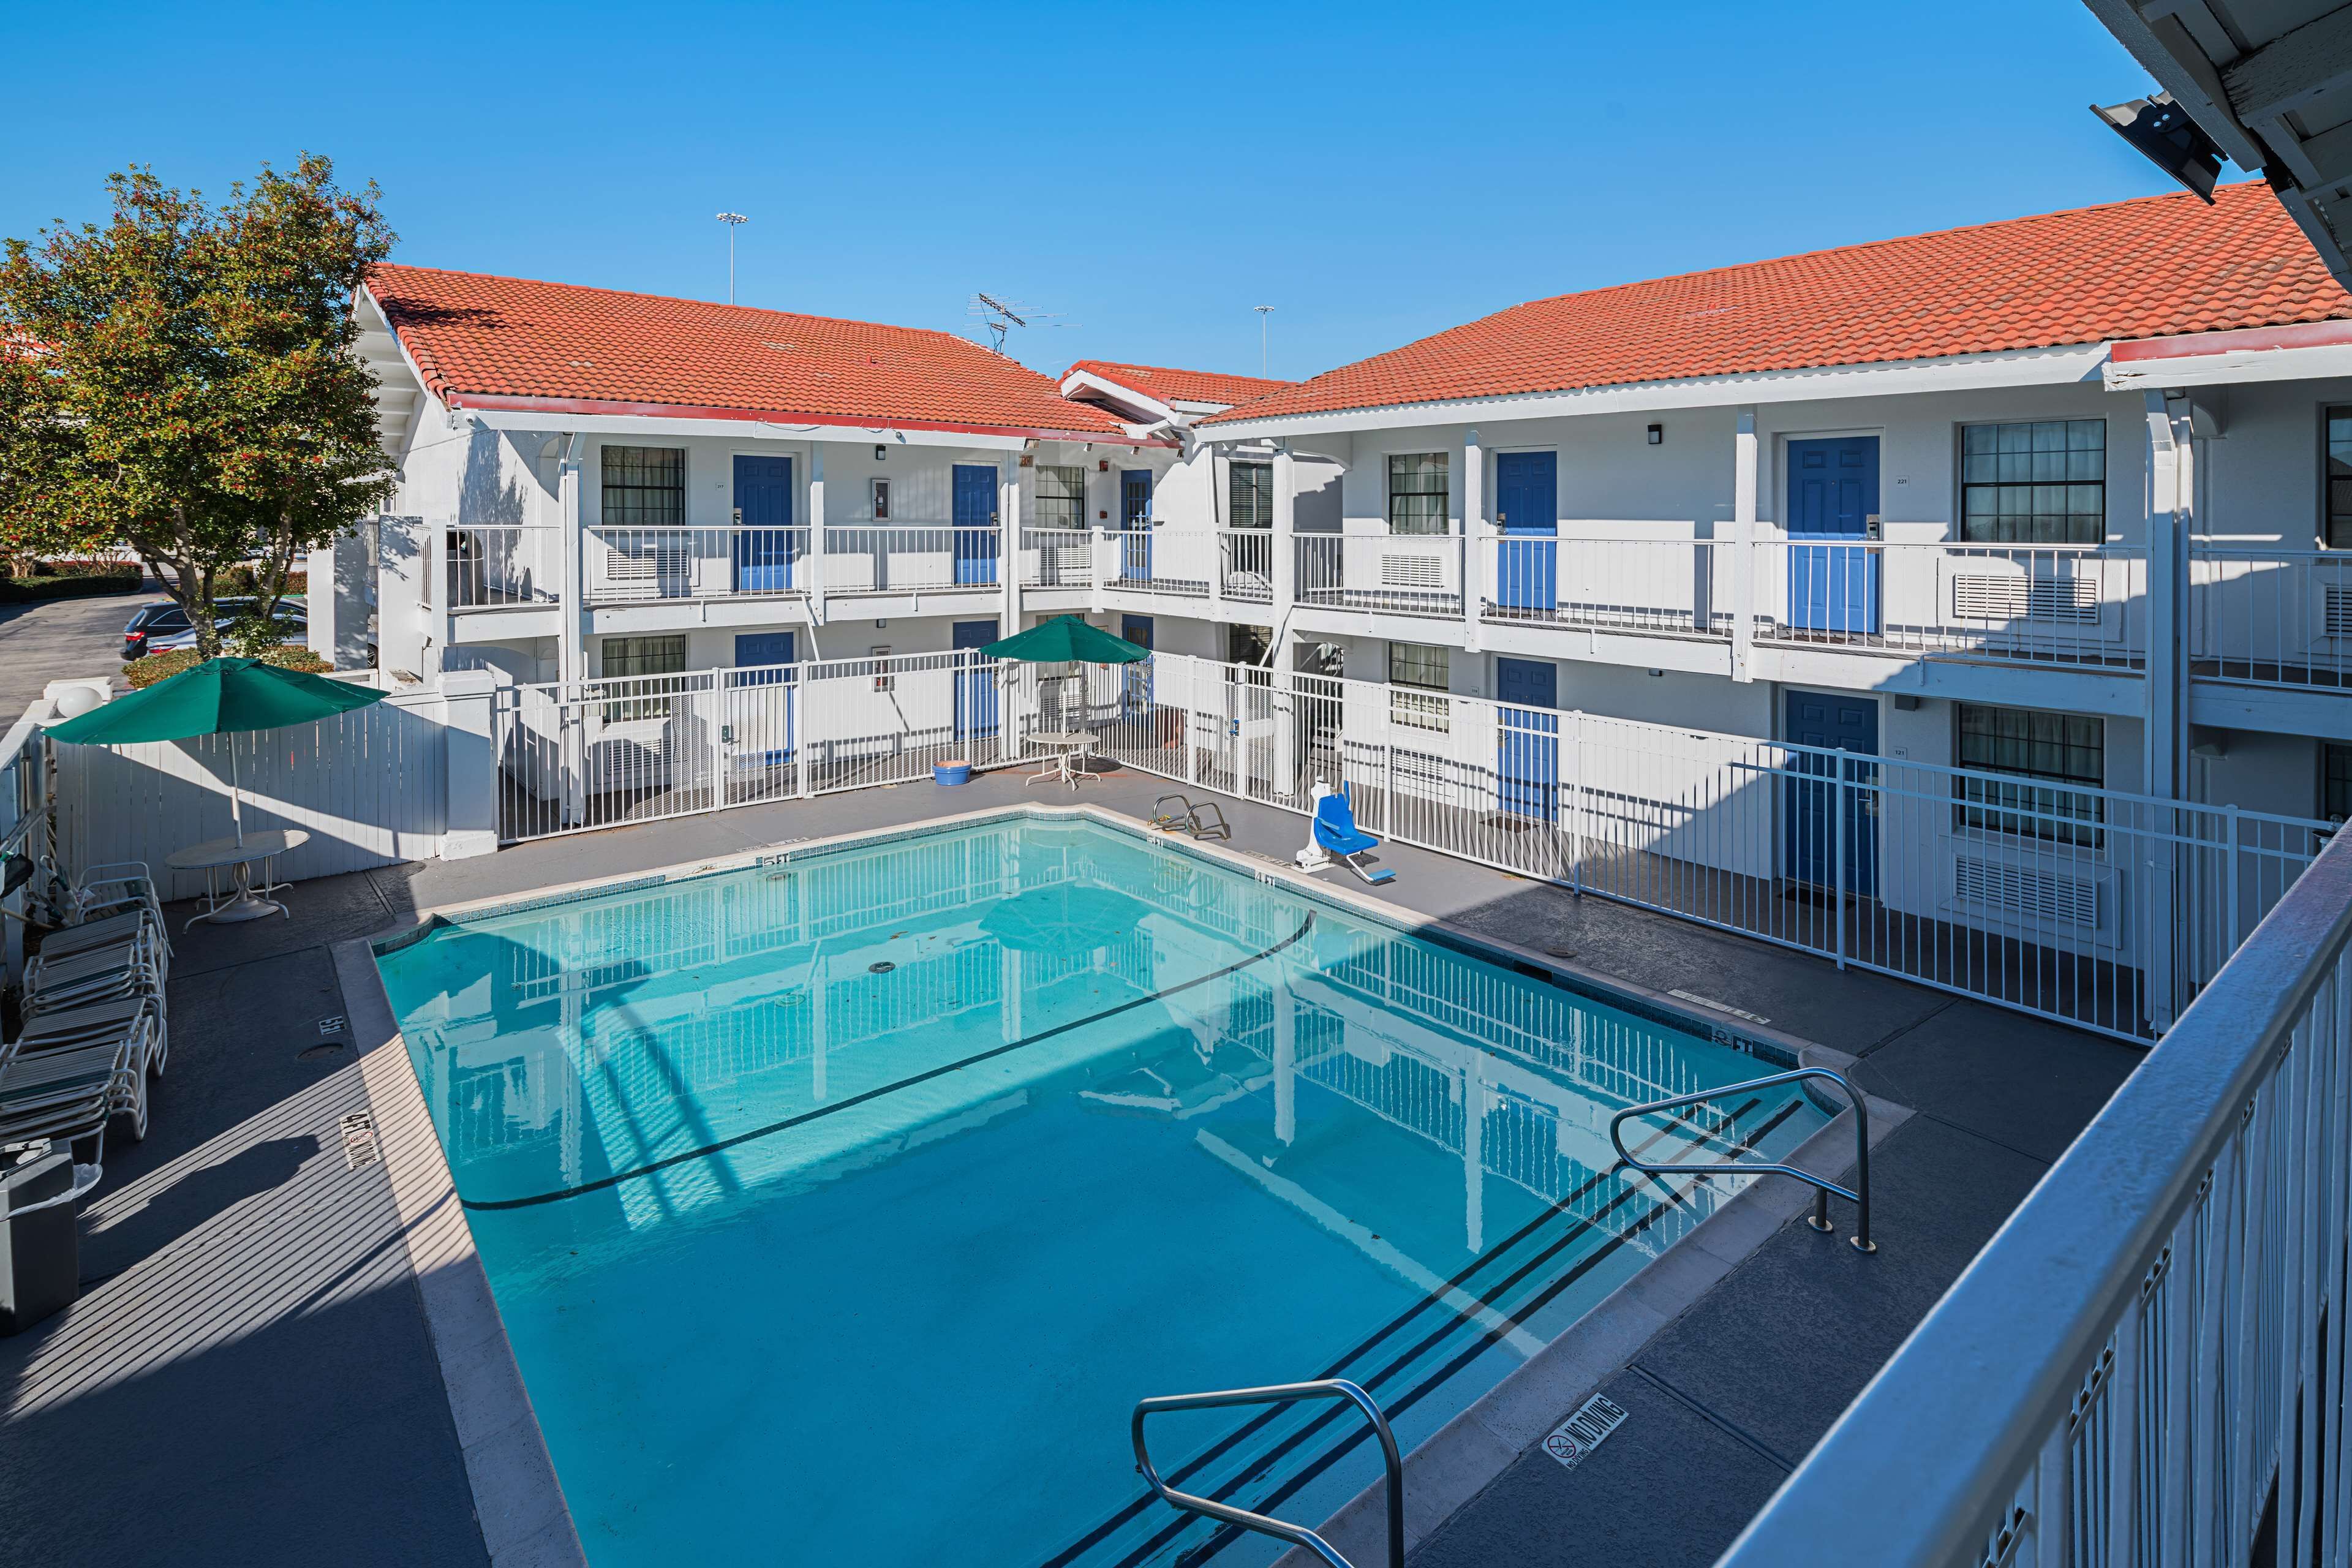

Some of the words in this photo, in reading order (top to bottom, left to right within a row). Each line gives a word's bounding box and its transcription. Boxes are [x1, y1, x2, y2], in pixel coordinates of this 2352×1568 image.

[764, 856, 775, 865] 5
[776, 853, 789, 864] FT
[1256, 872, 1262, 883] 4
[1265, 874, 1275, 886] FT
[1732, 1035, 1752, 1052] FT
[342, 1114, 368, 1124] 4
[344, 1120, 371, 1134] FT
[351, 1147, 377, 1167] DIVING
[1576, 1397, 1625, 1436] DIVING
[1564, 1422, 1597, 1447] NO
[1566, 1459, 1576, 1469] NO
[1573, 1448, 1589, 1463] DIVING
